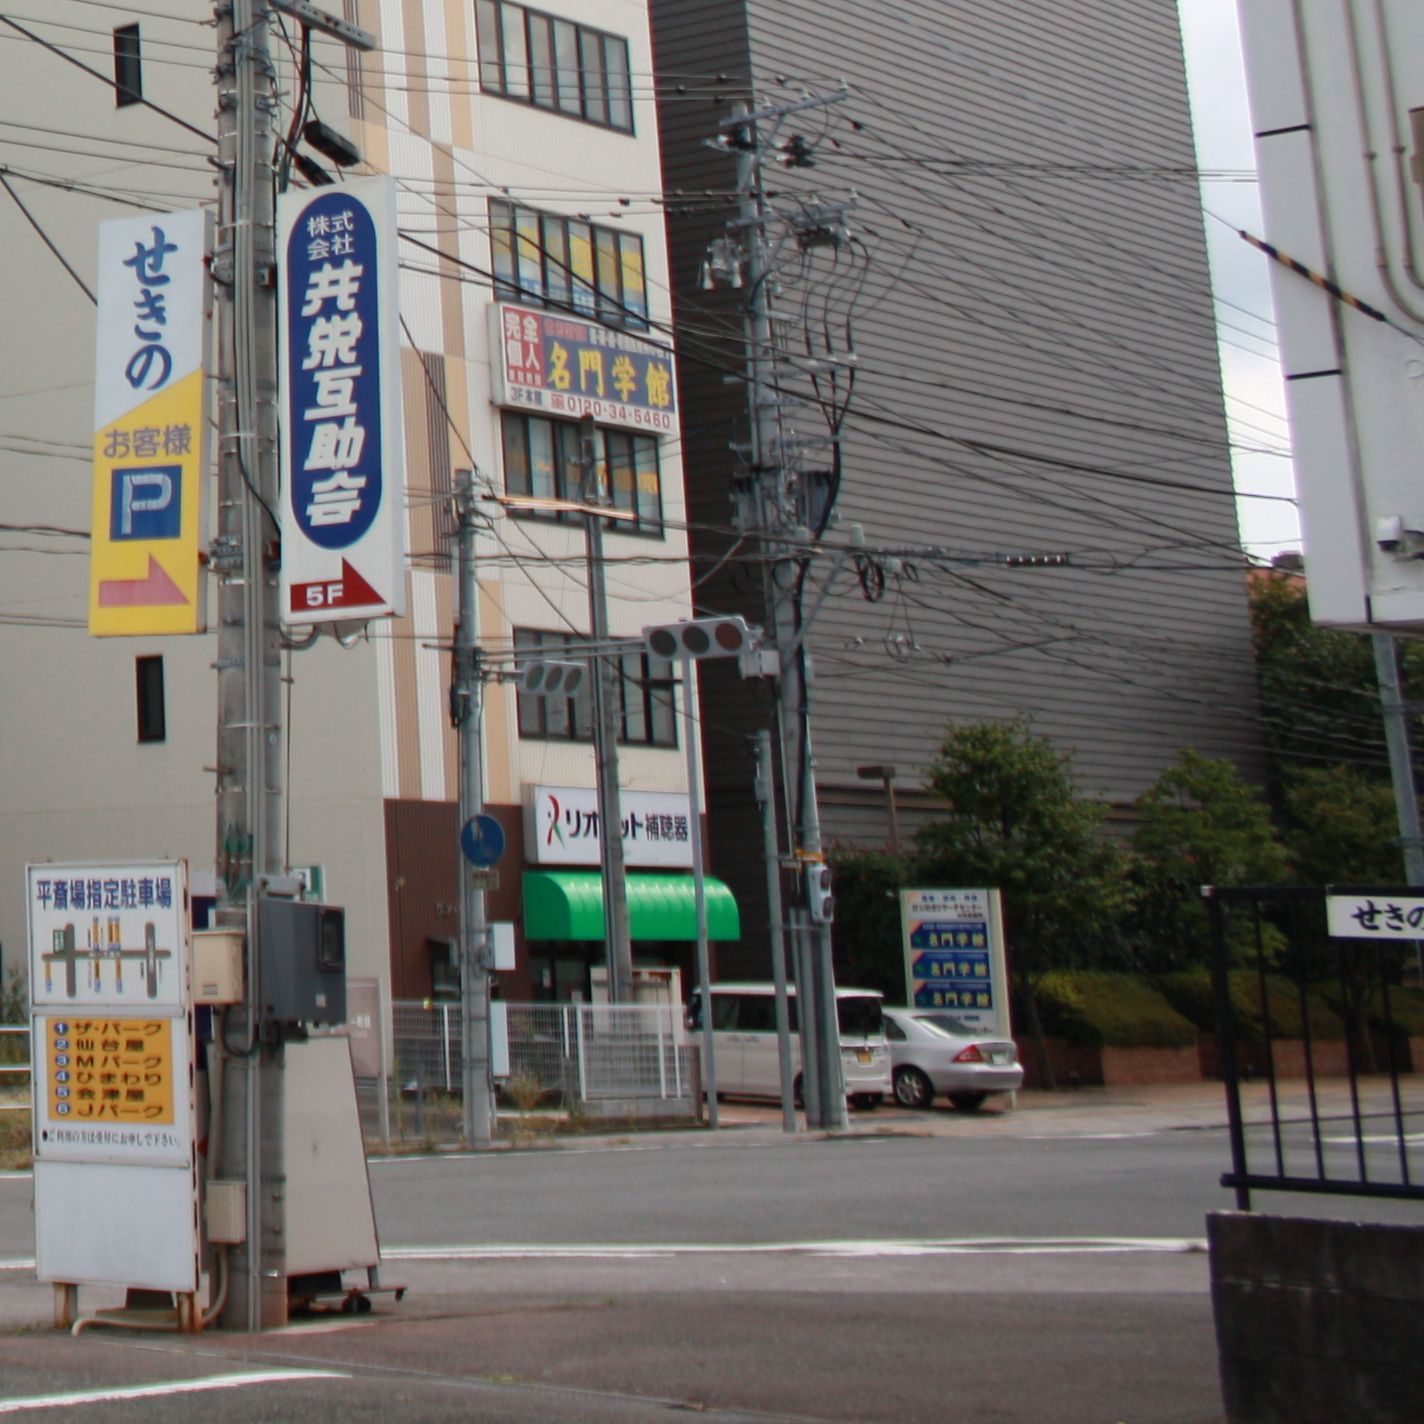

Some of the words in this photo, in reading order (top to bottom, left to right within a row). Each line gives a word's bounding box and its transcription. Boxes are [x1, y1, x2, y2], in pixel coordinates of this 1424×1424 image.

[307, 210, 353, 237] 株式
[307, 233, 355, 260] 会社
[122, 226, 178, 391] せきの
[504, 311, 539, 343] 完全
[507, 339, 540, 371] 個人
[547, 341, 670, 408] 名門学館
[301, 259, 367, 527] 共栄互助会
[103, 424, 192, 460] お客様
[121, 473, 173, 536] P
[305, 584, 343, 607] 5F
[76, 1073, 162, 1086] ひまわり
